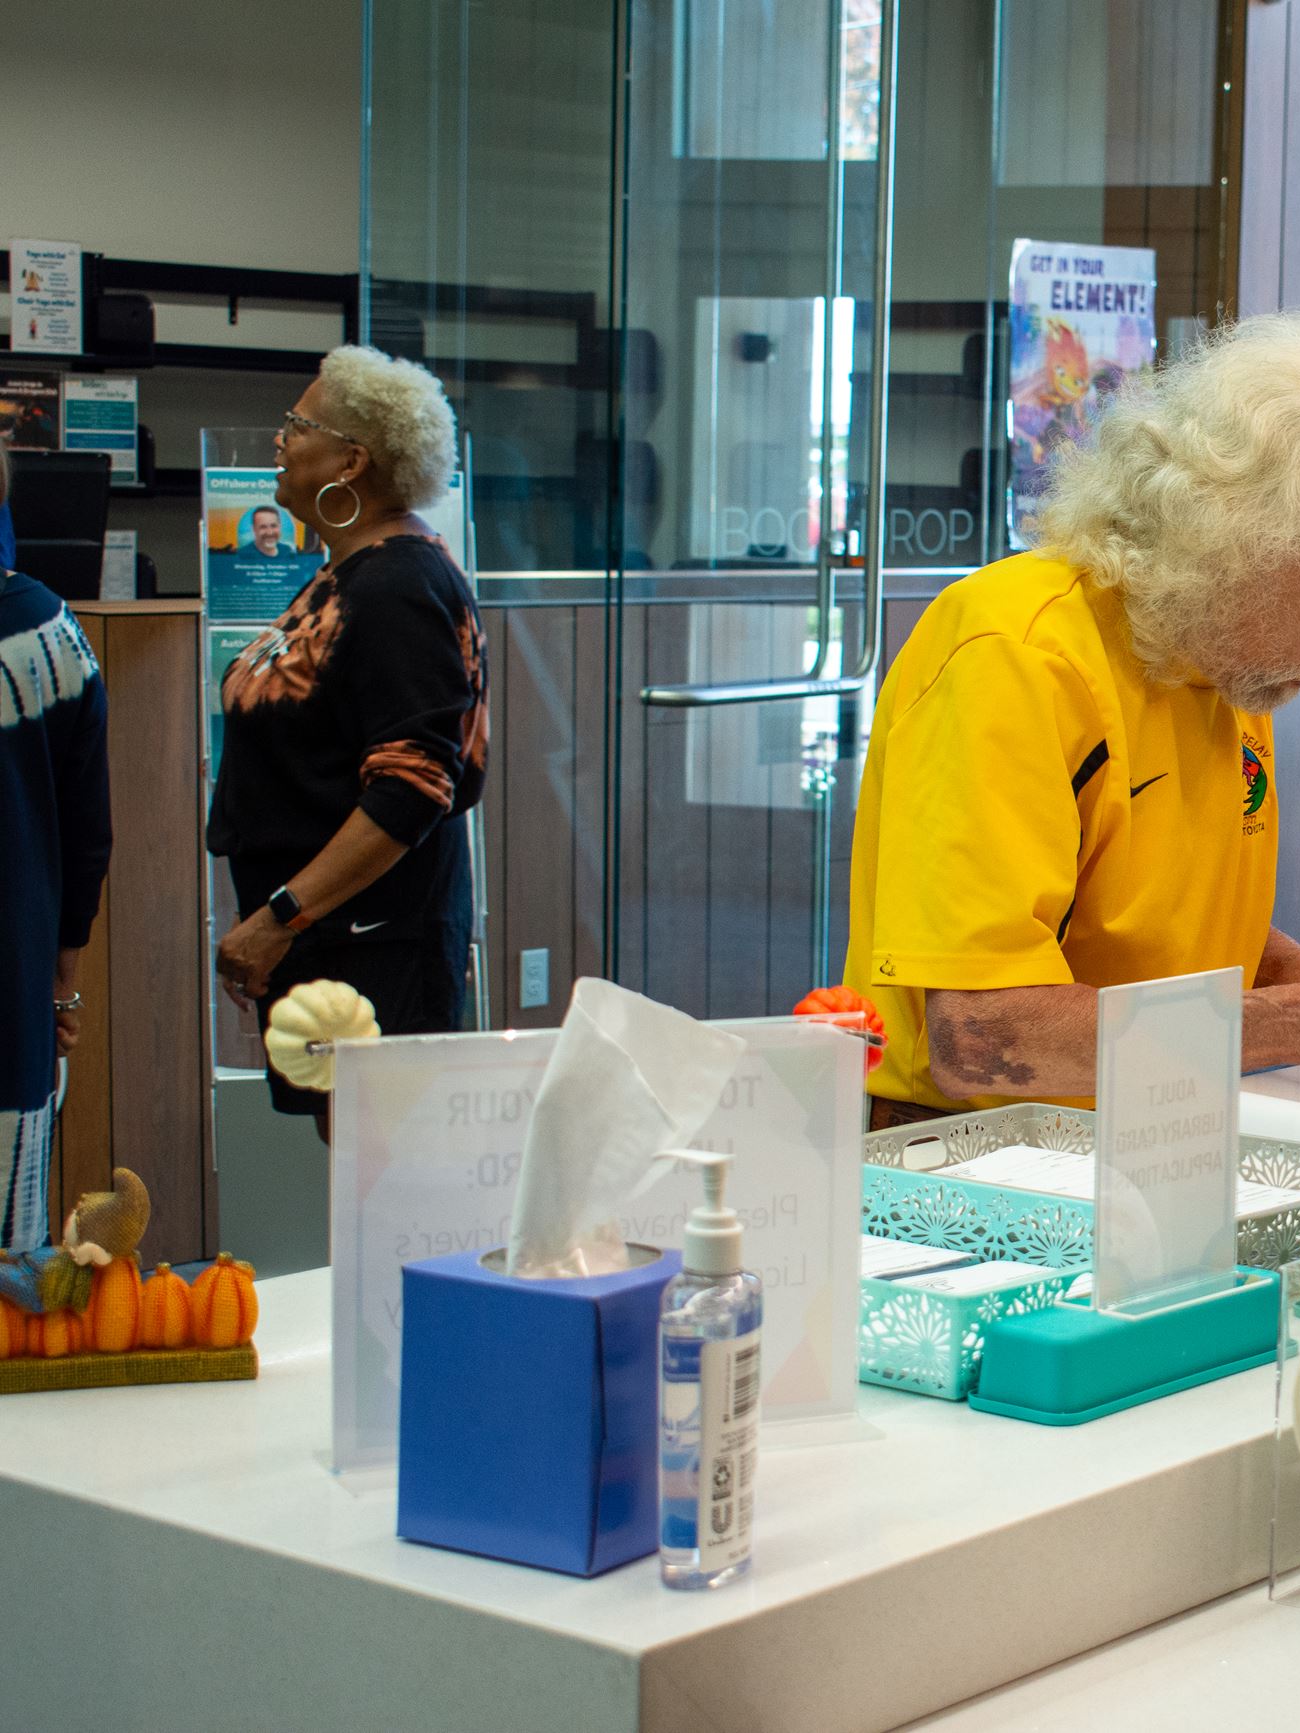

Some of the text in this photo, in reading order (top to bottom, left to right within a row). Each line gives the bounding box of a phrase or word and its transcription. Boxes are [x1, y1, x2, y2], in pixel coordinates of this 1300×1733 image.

[1030, 255, 1104, 276] GET IN YOUR
[1051, 280, 1146, 313] ELEMENT!
[861, 508, 974, 556] ROP
